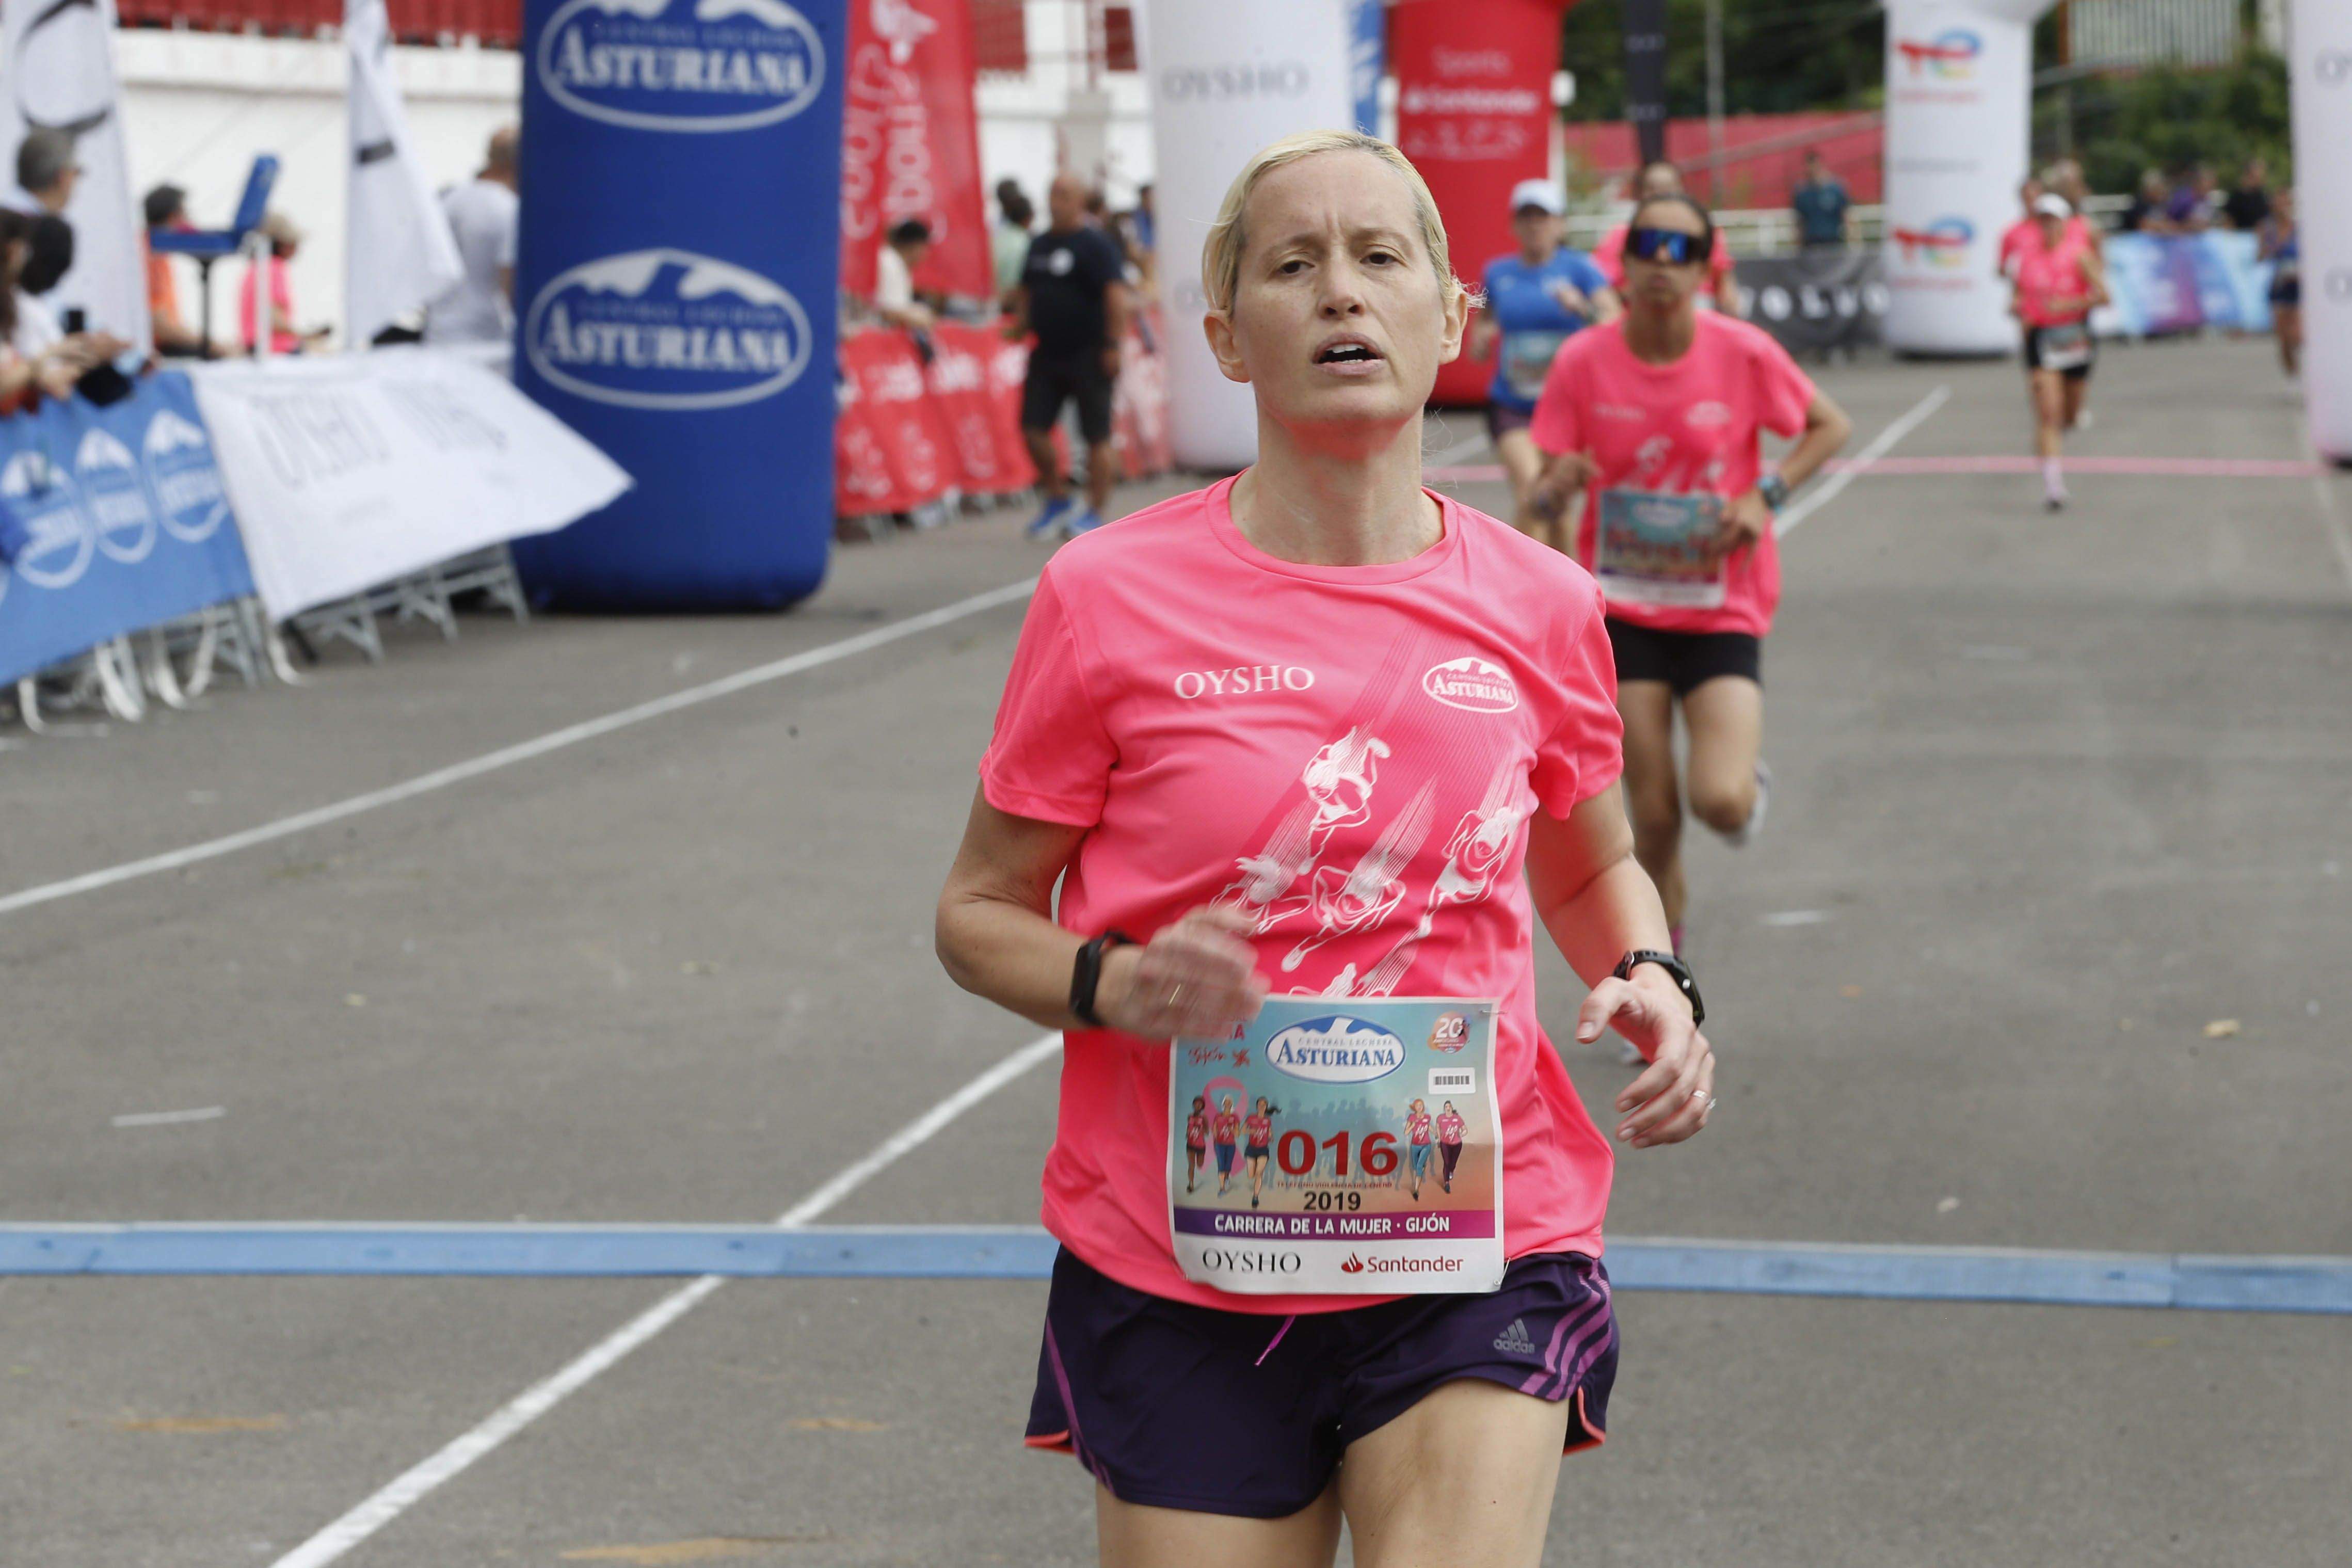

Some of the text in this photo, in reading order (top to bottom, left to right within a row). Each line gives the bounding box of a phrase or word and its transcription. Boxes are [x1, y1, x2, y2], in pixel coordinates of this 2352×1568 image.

[549, 23, 806, 96] ASTURIANA
[540, 299, 792, 374] ASTURIANA
[1174, 664, 1315, 699] OYSHO
[1432, 673, 1515, 705] ASTURIANA
[1276, 1038, 1396, 1066] ASTURIANA
[1277, 1129, 1399, 1176] 016
[1303, 1191, 1362, 1211] 2019
[1214, 1212, 1450, 1234] CARRERA DE LA MUJER GIJÓN
[1202, 1247, 1464, 1274] OYSHO Santander
